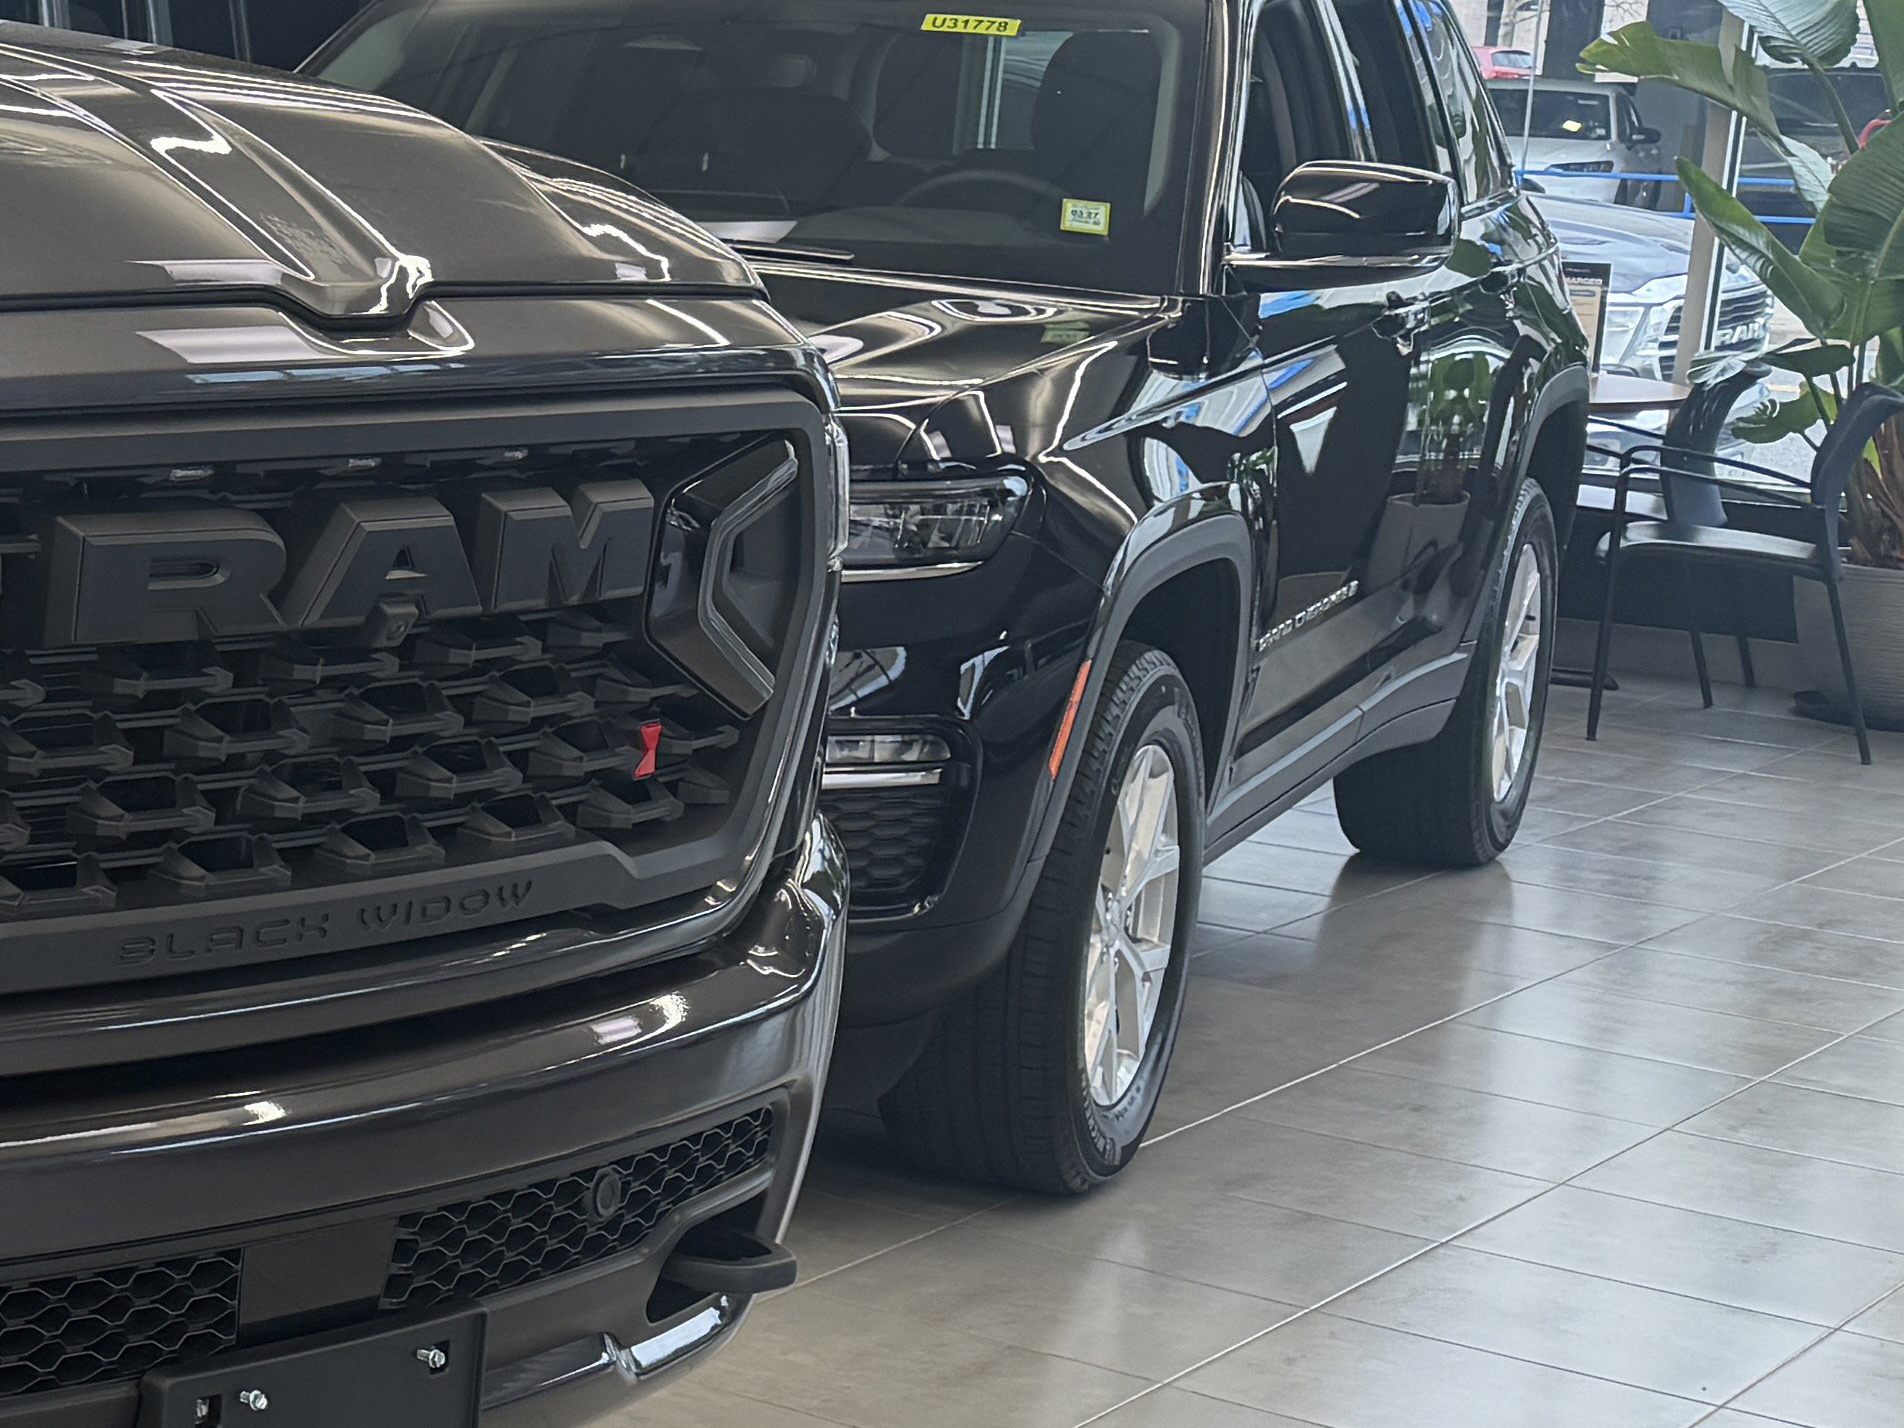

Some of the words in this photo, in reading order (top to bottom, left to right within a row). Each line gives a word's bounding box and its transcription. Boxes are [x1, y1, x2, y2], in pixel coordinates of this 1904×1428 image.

[932, 16, 1009, 33] U31778
[50, 479, 655, 645] RAM
[117, 913, 330, 966] BLACK
[356, 880, 532, 933] WIDOW
